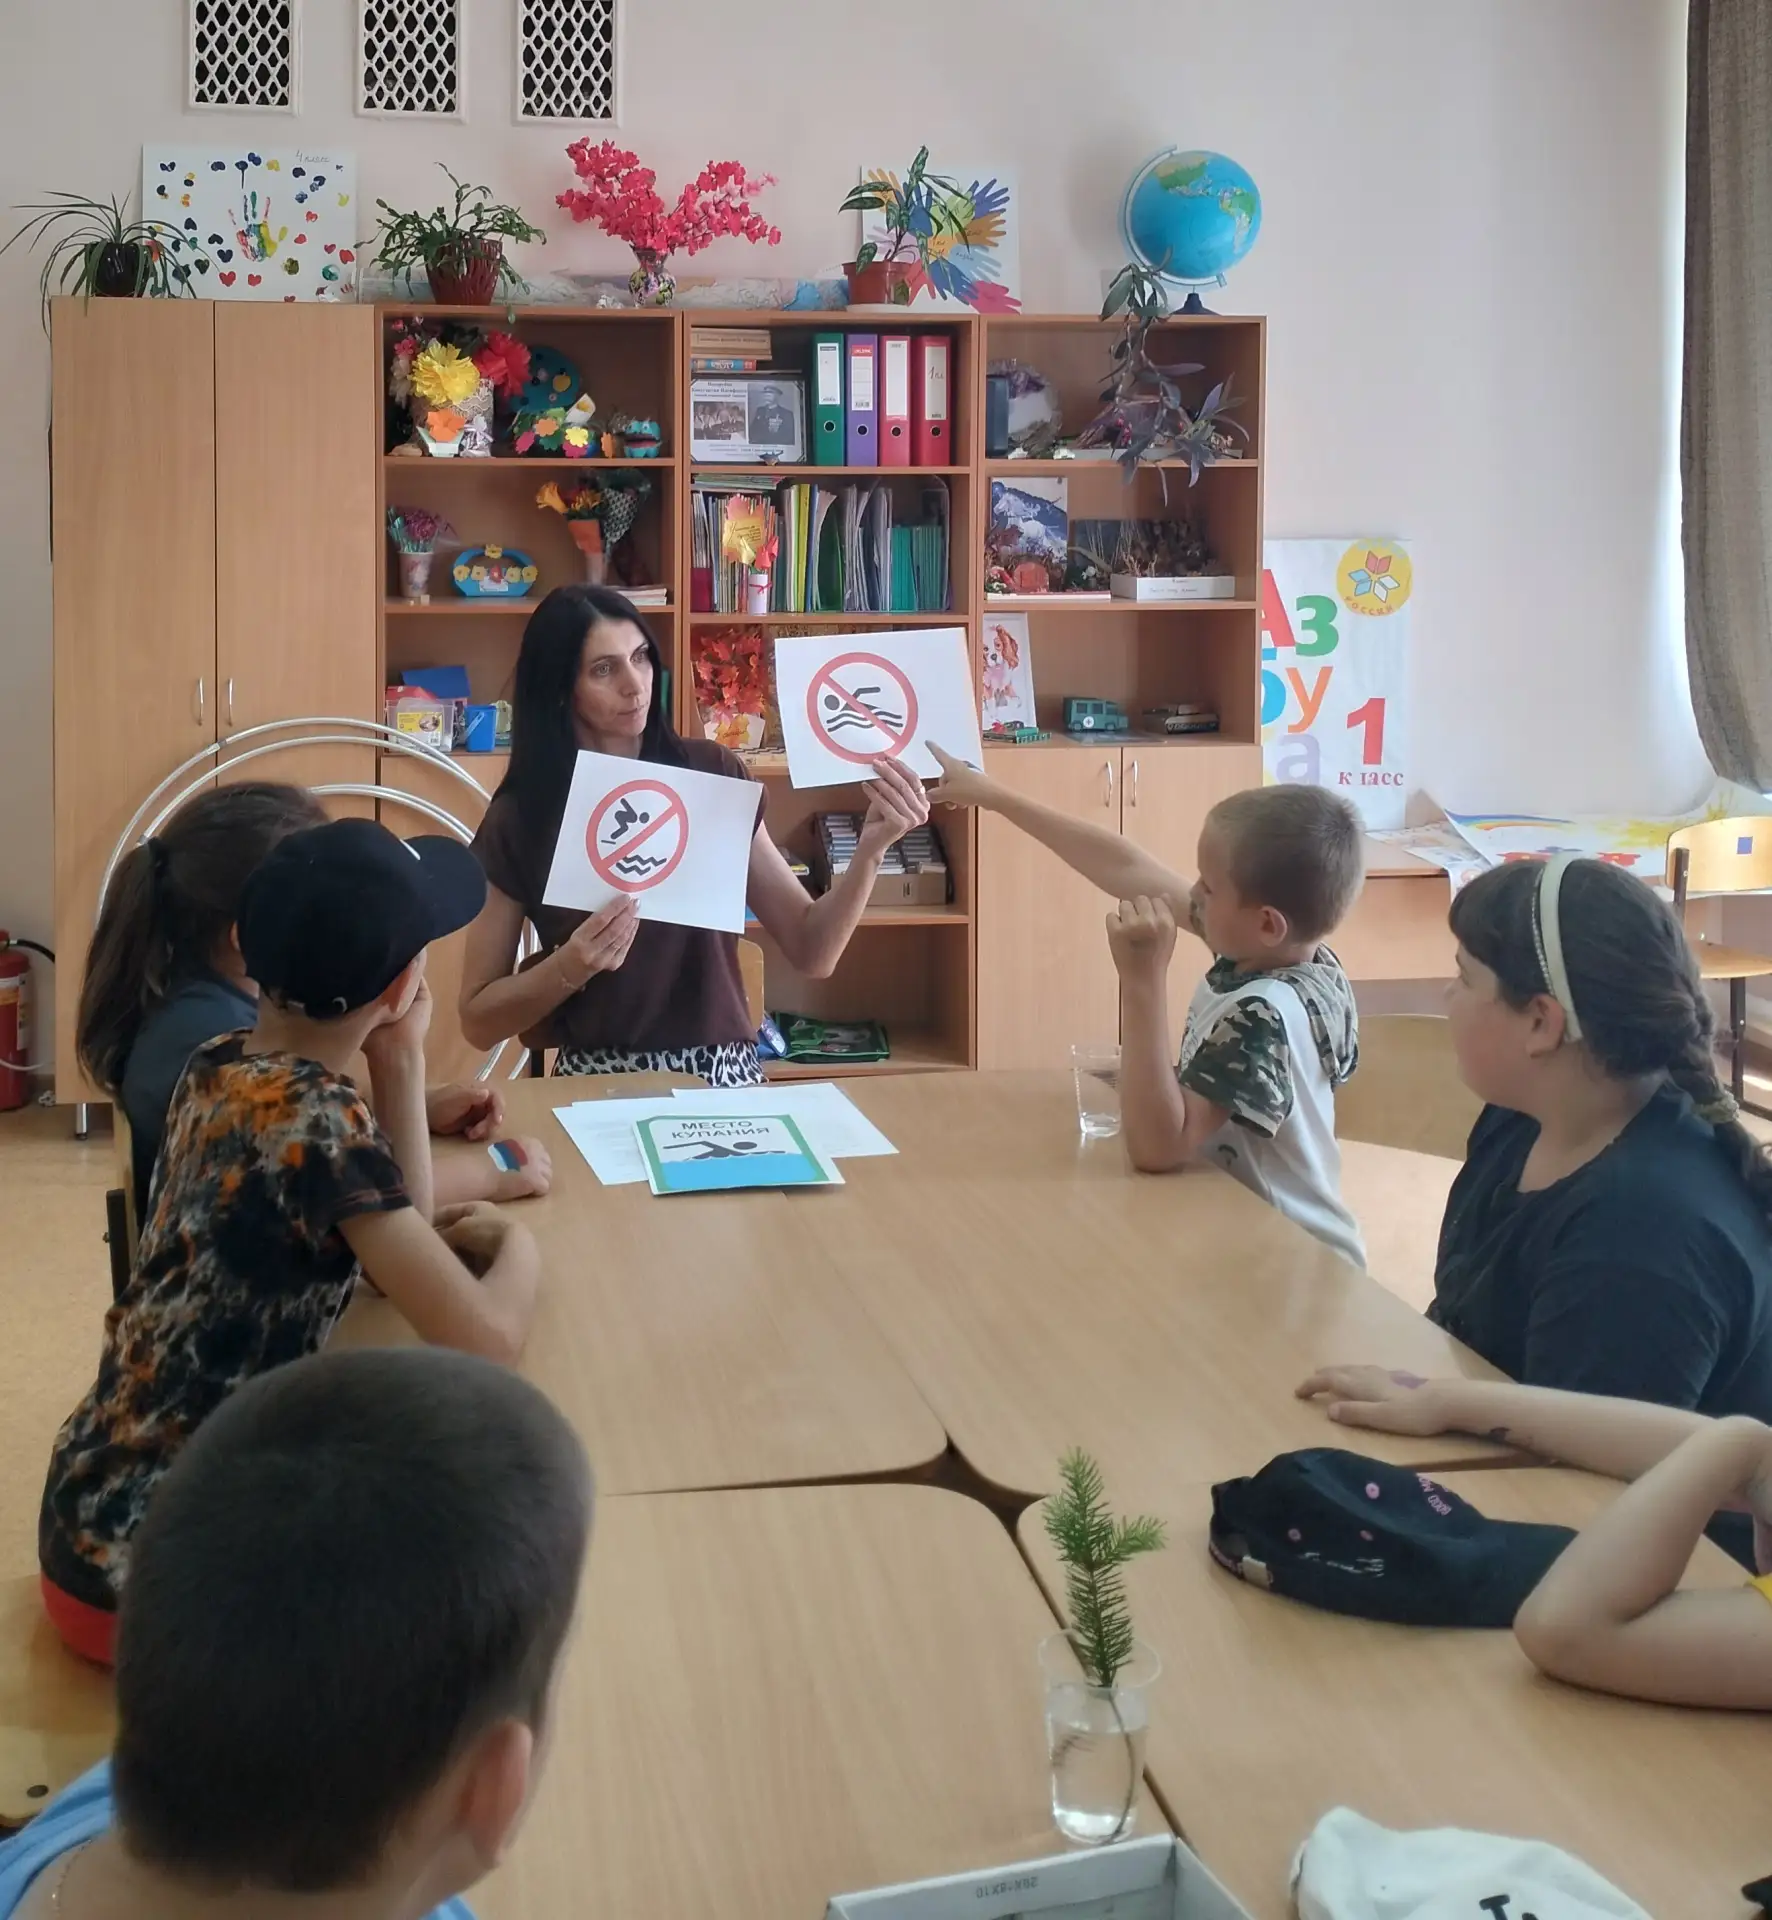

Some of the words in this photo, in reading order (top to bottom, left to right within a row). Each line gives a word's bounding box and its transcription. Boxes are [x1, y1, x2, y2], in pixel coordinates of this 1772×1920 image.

[1347, 698, 1386, 765] 1
[681, 1121, 753, 1130] МЕСТО
[671, 1127, 770, 1139] КУПАНИЯ
